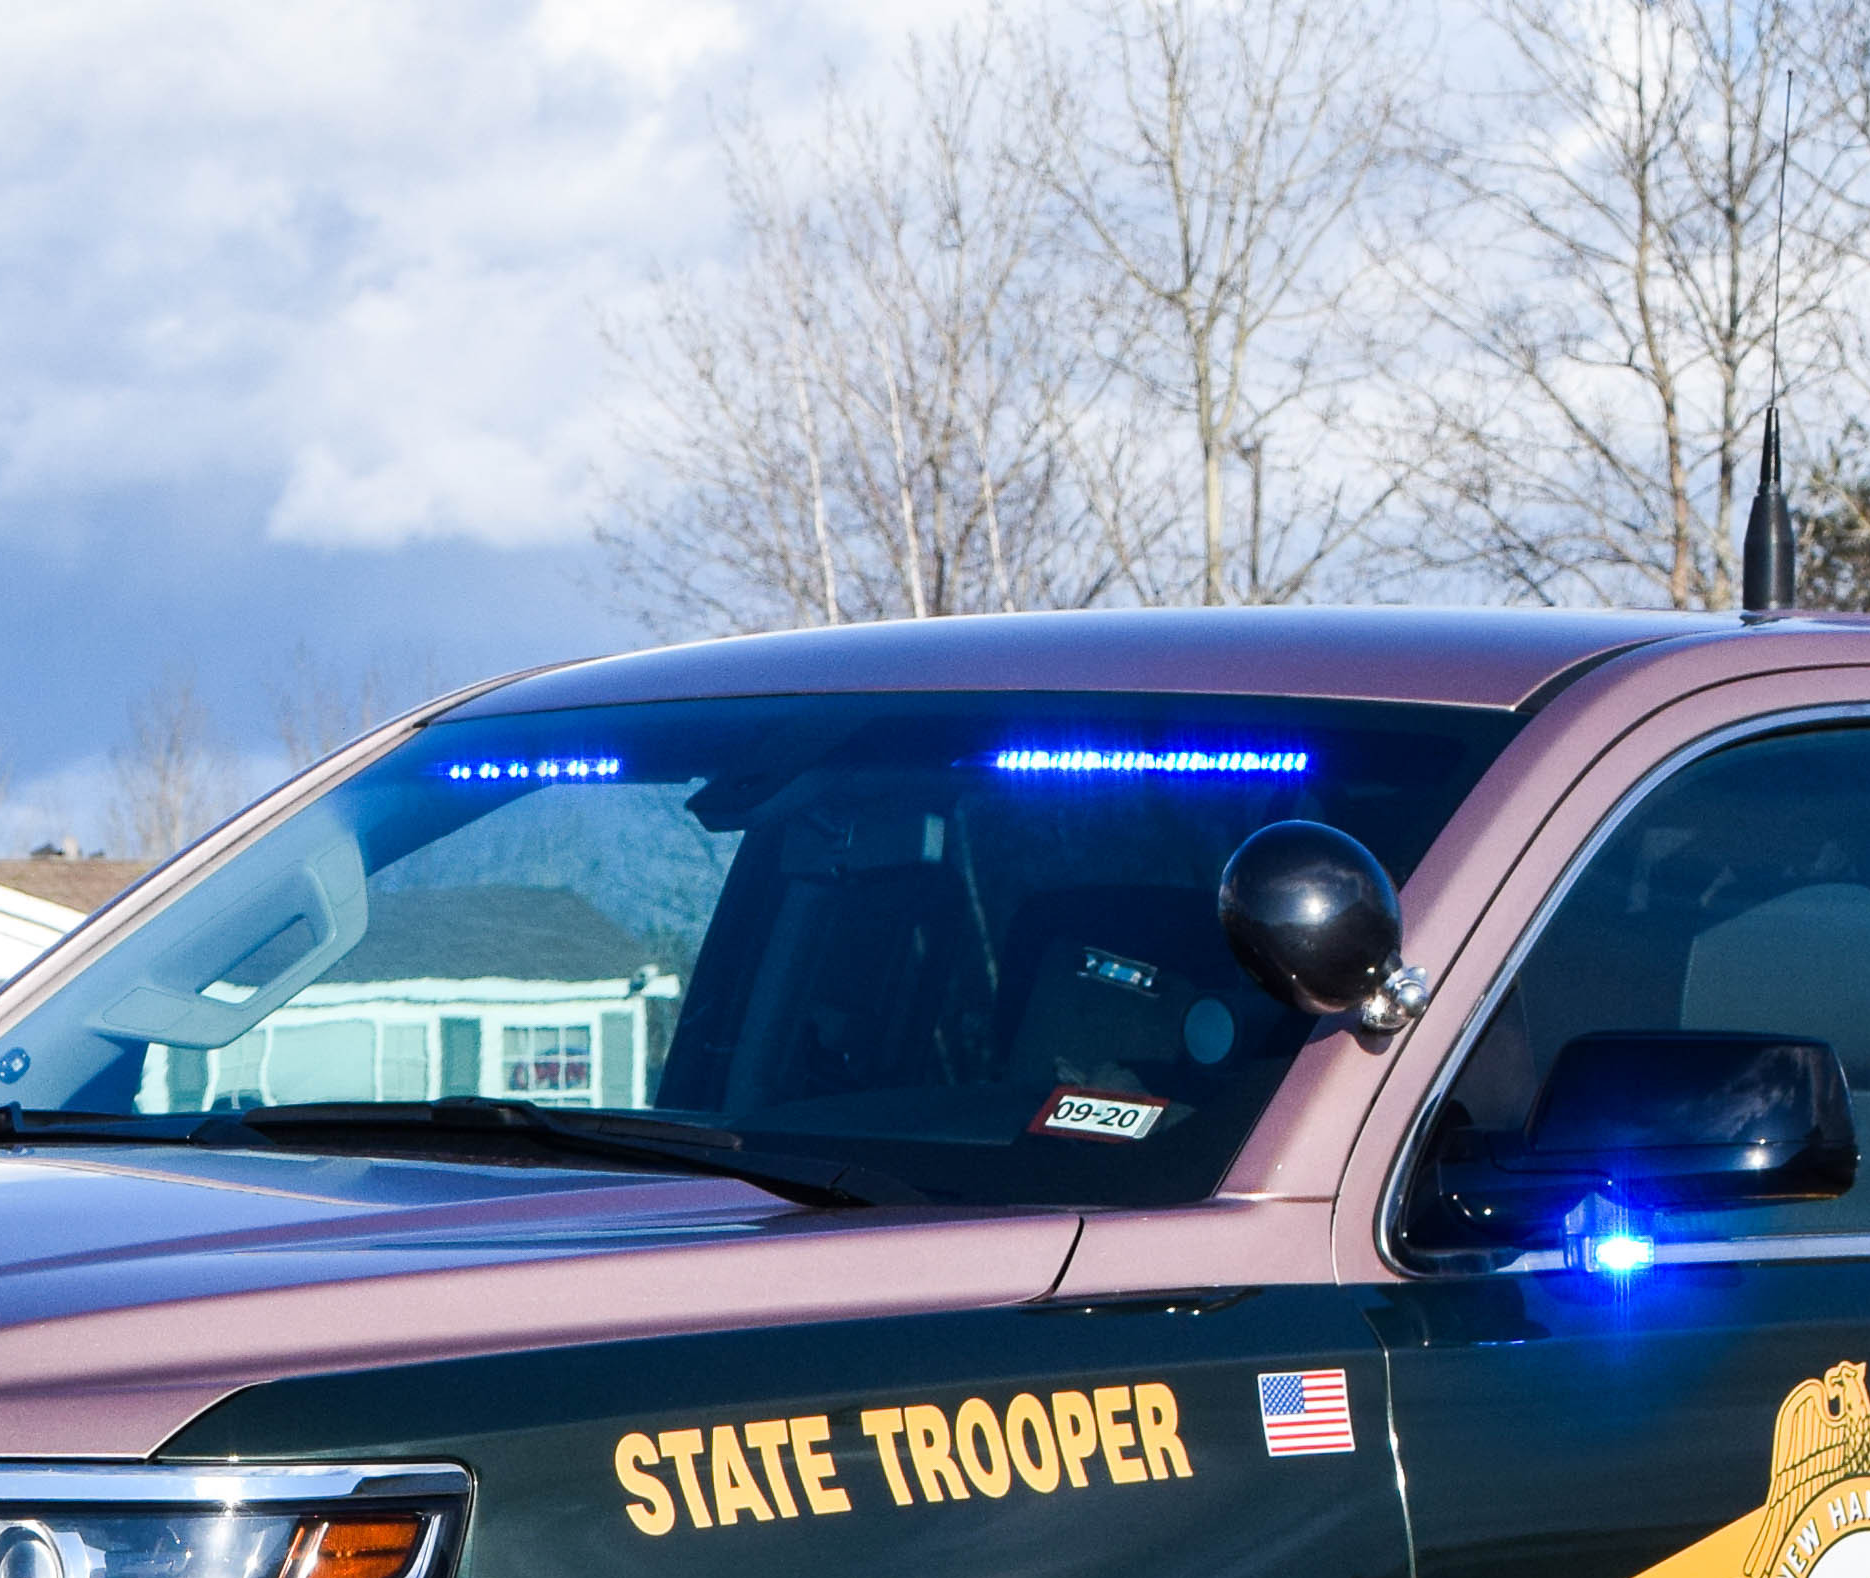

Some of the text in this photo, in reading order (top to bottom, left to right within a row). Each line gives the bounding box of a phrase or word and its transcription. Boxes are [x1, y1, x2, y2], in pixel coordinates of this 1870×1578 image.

[1054, 1101, 1140, 1129] 09-20
[615, 1383, 1193, 1536] STATE TROOPER
